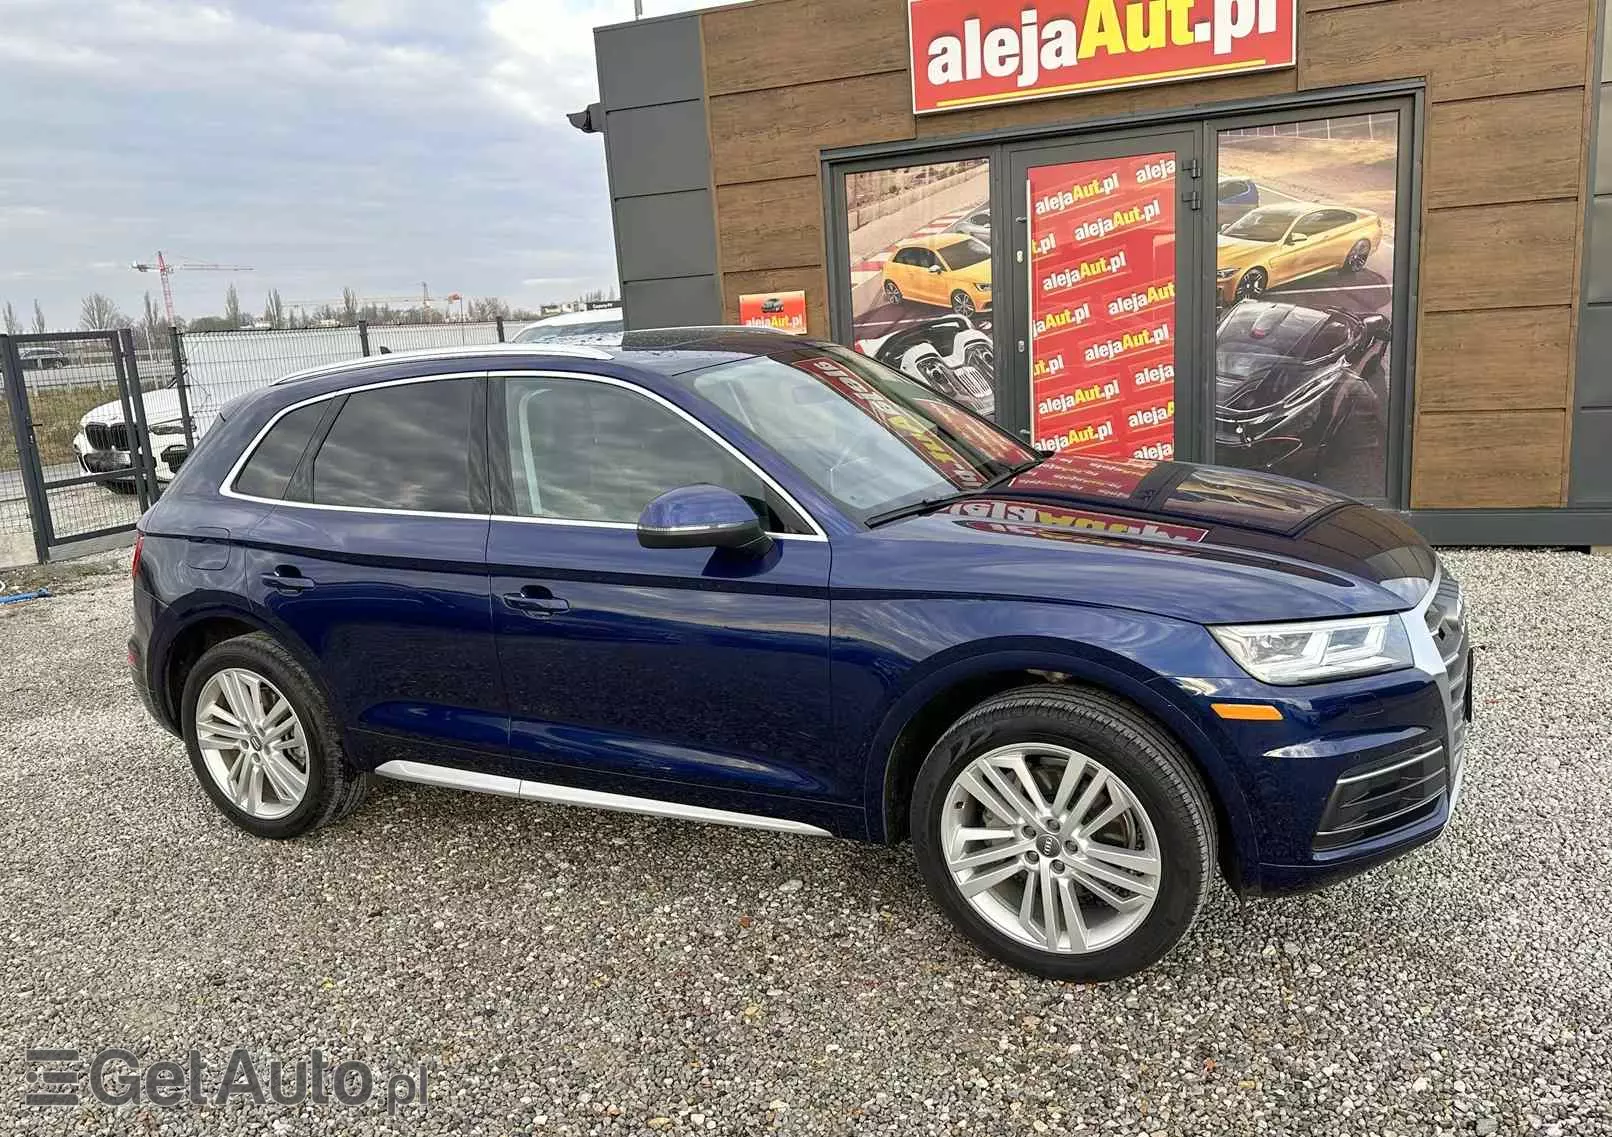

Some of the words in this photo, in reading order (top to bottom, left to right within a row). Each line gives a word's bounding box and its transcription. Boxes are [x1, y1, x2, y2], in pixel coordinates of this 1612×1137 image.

[1035, 173, 1119, 214] alejaAut.pl
[1074, 199, 1160, 240] alejaAut.pl
[1043, 251, 1126, 291] alejaAut.pl
[1085, 323, 1169, 361] alejaAut.pl
[1038, 379, 1120, 414] alejaAut.pl
[1034, 421, 1113, 452] alejaAut.pl
